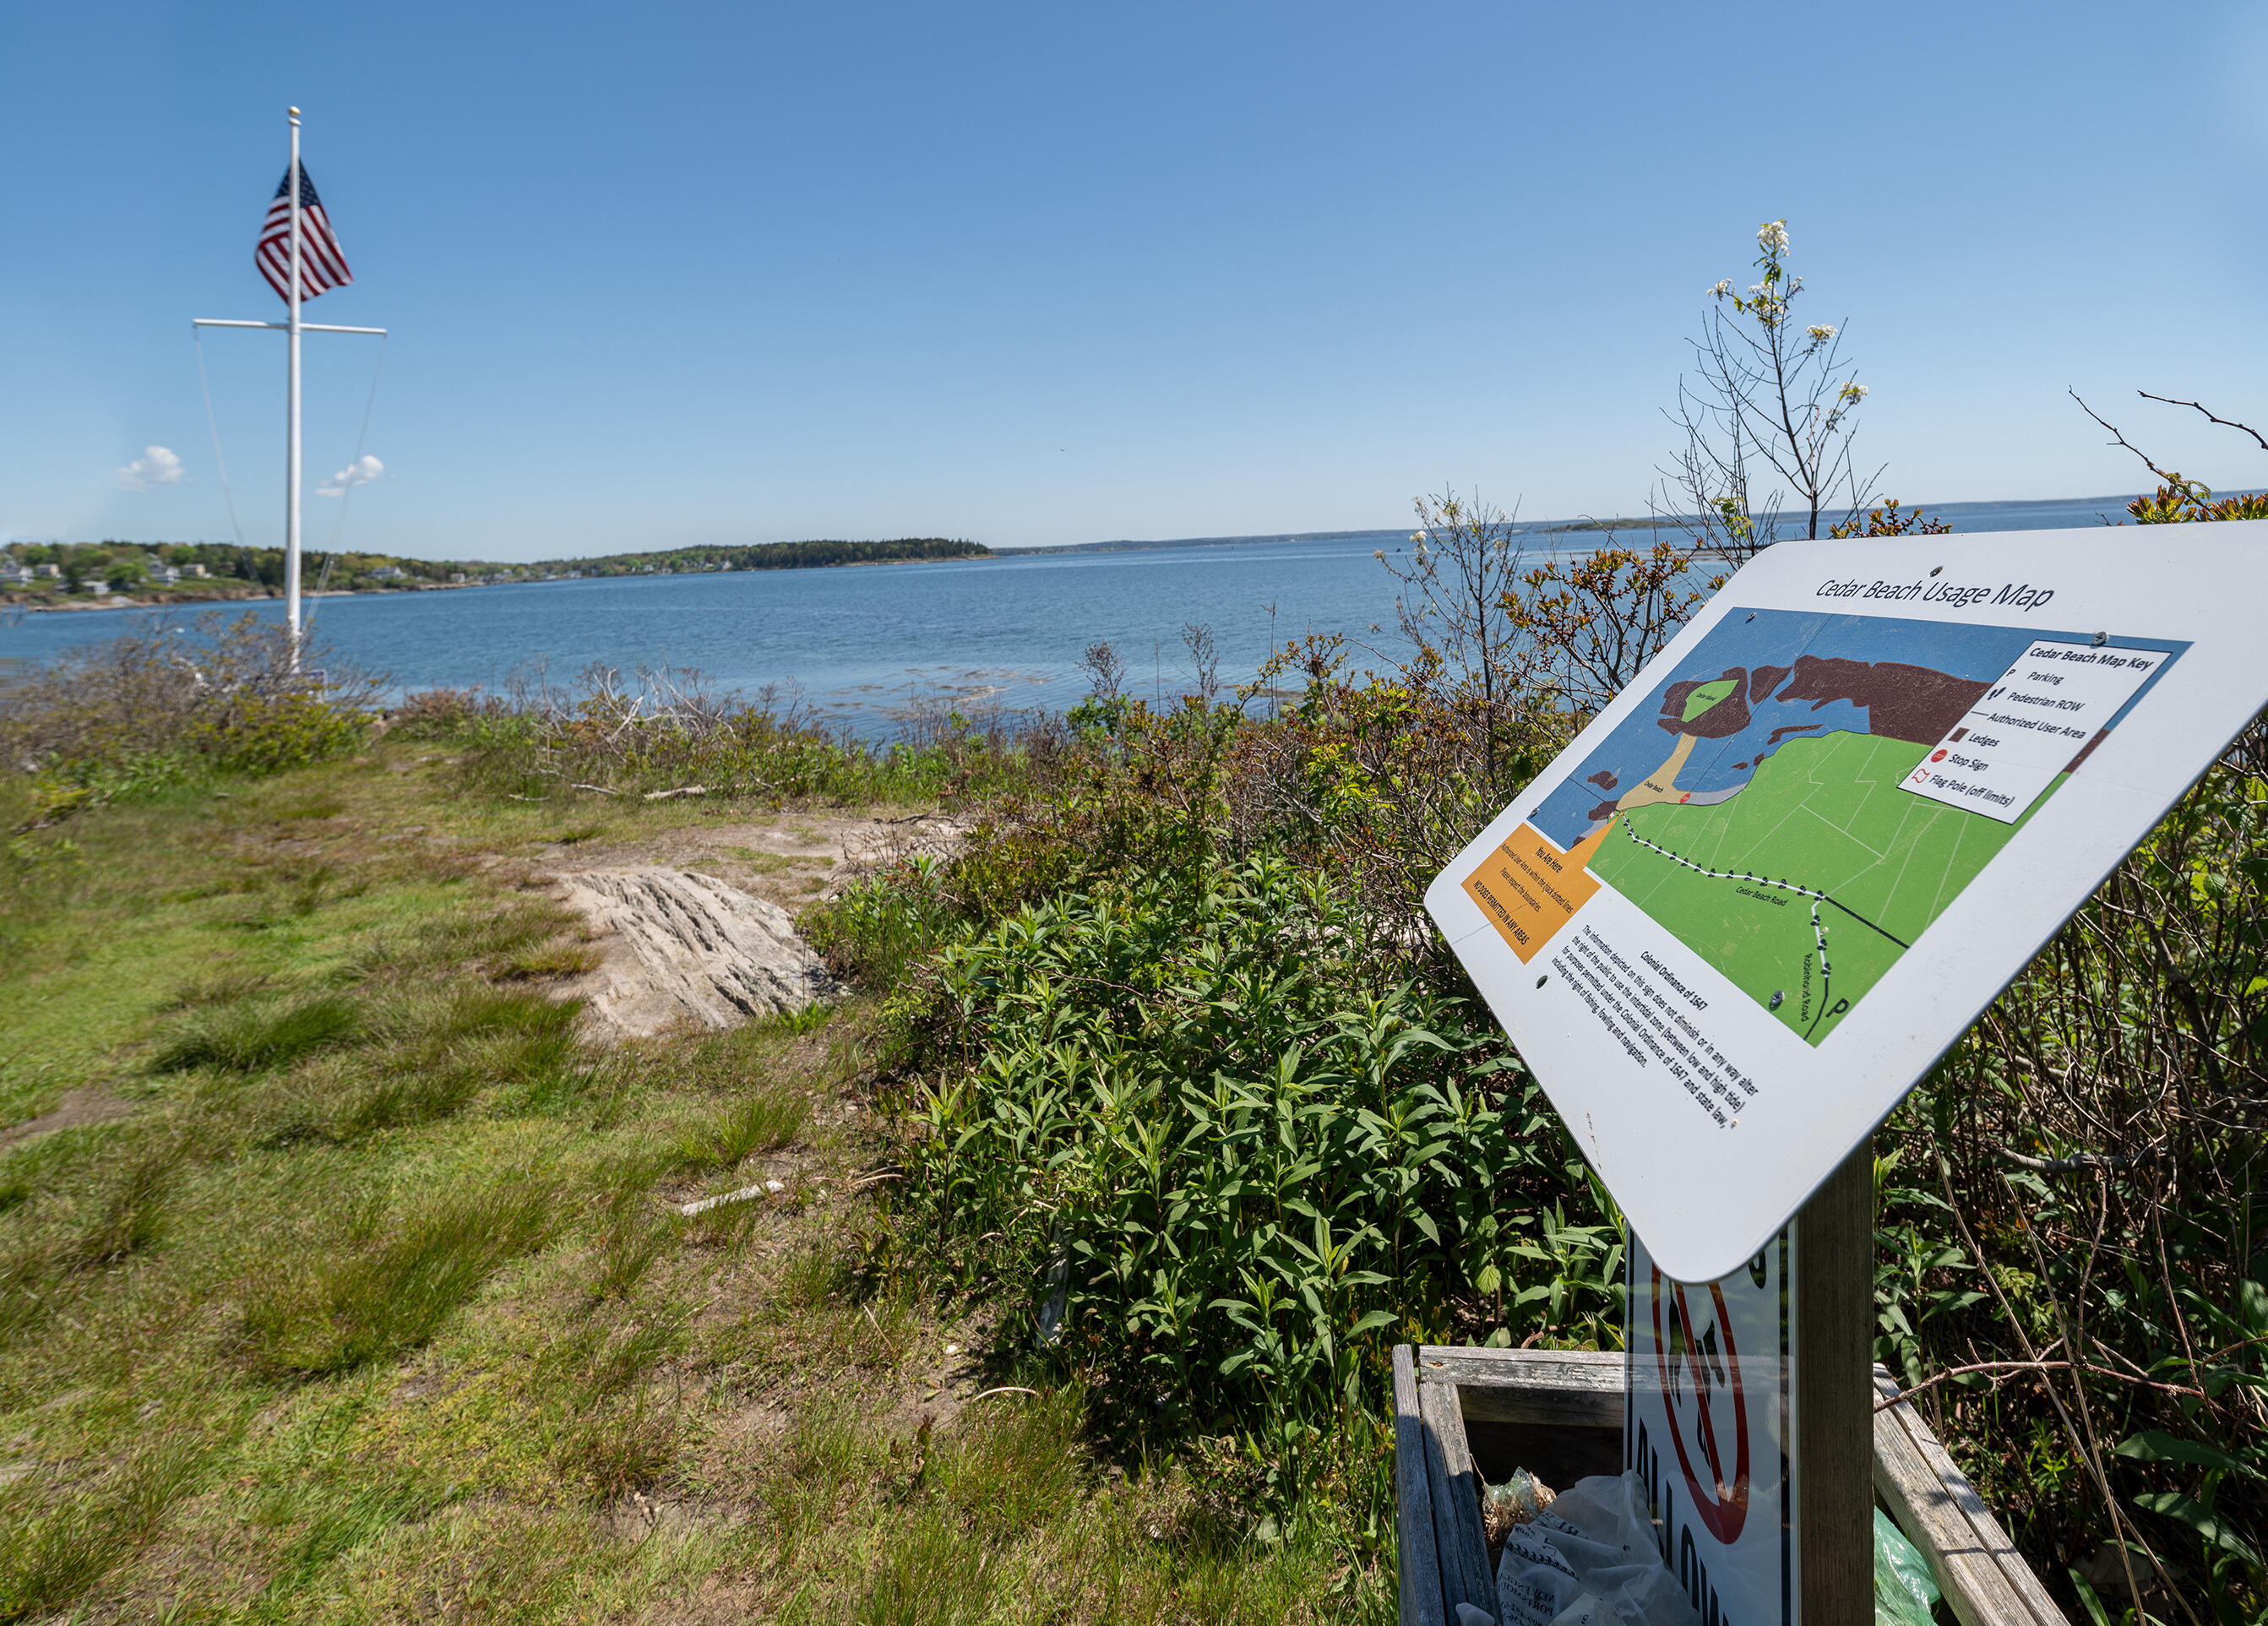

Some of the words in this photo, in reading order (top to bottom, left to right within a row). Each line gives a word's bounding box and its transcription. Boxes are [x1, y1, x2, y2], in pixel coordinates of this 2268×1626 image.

[1816, 579, 1867, 597] Cedar
[1862, 579, 1923, 601] Beach
[1923, 581, 1991, 607] Usage
[1990, 584, 2054, 612] Map
[2029, 647, 2063, 659] Cedar
[2060, 650, 2097, 663] Beach
[2097, 654, 2127, 668] Map
[2126, 657, 2154, 672] Key
[2005, 668, 2016, 677] P
[2026, 671, 2064, 686] Parking
[2006, 692, 2056, 707] Pedestrian
[2054, 699, 2086, 711] ROW
[1987, 712, 2040, 729] Authorized
[2037, 721, 2062, 733] User
[2059, 726, 2086, 739] Area
[1968, 732, 2000, 747] Ledges
[1948, 753, 1970, 767] Stop
[1967, 759, 1988, 771] Sign
[1644, 780, 1654, 789] Cedar
[1651, 784, 1663, 793] Beach
[1928, 775, 1949, 788] Flag
[1946, 780, 1967, 792] Pole
[1964, 785, 1988, 797] (off
[1982, 789, 2015, 808] limits)
[1501, 843, 1517, 859] Authorized
[1513, 854, 1523, 865] User
[1519, 860, 1529, 871] Area
[1535, 846, 1546, 858] You
[1542, 852, 1553, 865] Are
[1548, 858, 1563, 873] Here
[1499, 867, 1511, 880] Please
[1526, 866, 1531, 874] is
[1528, 869, 1541, 883] within
[1472, 879, 1482, 889] NO
[1507, 876, 1521, 890] respect
[1517, 885, 1526, 895] the
[1536, 878, 1546, 888] the
[1543, 881, 1555, 893] black
[1477, 884, 1491, 899] DOGS
[1550, 890, 1567, 905] dotted
[1736, 886, 1753, 897] Cedar
[1752, 889, 1770, 902] Beach
[1770, 895, 1788, 906] Road
[1485, 894, 1507, 918] PERMITTED
[1521, 889, 1542, 913] boundaries.
[1561, 900, 1574, 914] lines.
[1501, 913, 1511, 923] IN
[1504, 918, 1519, 932] ANY
[1512, 927, 1530, 945] AREAS
[1561, 945, 1570, 955] for
[1551, 955, 1569, 978] including
[1565, 952, 1585, 972] purposes
[1564, 972, 1575, 983] the
[1580, 969, 1605, 992] permitted
[1640, 950, 1663, 971] Colonial
[1658, 966, 1686, 994] Ordinance
[1683, 990, 1695, 999] of
[1689, 994, 1708, 1011] 1647
[1802, 953, 1813, 998] Robinhood
[1570, 979, 1584, 993] right
[1580, 989, 1590, 998] of
[1584, 992, 1600, 1014] fishing,
[1600, 988, 1615, 1004] under
[1582, 924, 1591, 936] The
[1588, 931, 1613, 956] information
[1609, 952, 1632, 973] depicted
[1627, 970, 1636, 979] on
[1634, 975, 1645, 987] this
[1641, 984, 1655, 998] sign
[1652, 993, 1667, 1009] does
[1664, 1006, 1678, 1019] not
[1674, 1014, 1700, 1041] diminish
[1697, 1037, 1708, 1047] or
[1704, 1042, 1714, 1055] in
[1711, 1052, 1727, 1068] any
[1724, 1063, 1742, 1082] way
[1738, 1077, 1759, 1096] alter
[1612, 1000, 1623, 1013] the
[1801, 998, 1811, 1022] Road
[1825, 998, 1850, 1018] P
[1571, 935, 1580, 946] the
[1577, 942, 1590, 954] right
[1590, 954, 1600, 965] the
[1595, 962, 1612, 978] public
[1608, 973, 1617, 982] to
[1613, 979, 1624, 991] use
[1621, 986, 1632, 998] the
[1629, 993, 1655, 1020] intertidal
[1649, 1015, 1665, 1032] zone
[1660, 1026, 1689, 1058] (between
[1686, 1052, 1701, 1069] low
[1697, 1065, 1716, 1081] and
[1709, 1074, 1727, 1096] high
[1724, 1090, 1745, 1113] tide)
[1596, 1008, 1616, 1031] fowling
[1620, 1009, 1643, 1032] Colonial
[1612, 1026, 1626, 1040] and
[1638, 1028, 1666, 1059] Ordinance
[1620, 1036, 1647, 1068] navigation.
[1662, 1056, 1675, 1066] of
[1669, 1062, 1689, 1080] 1647
[1683, 1079, 1701, 1095] and
[1694, 1091, 1714, 1112] state
[1711, 1106, 1727, 1128] law,
